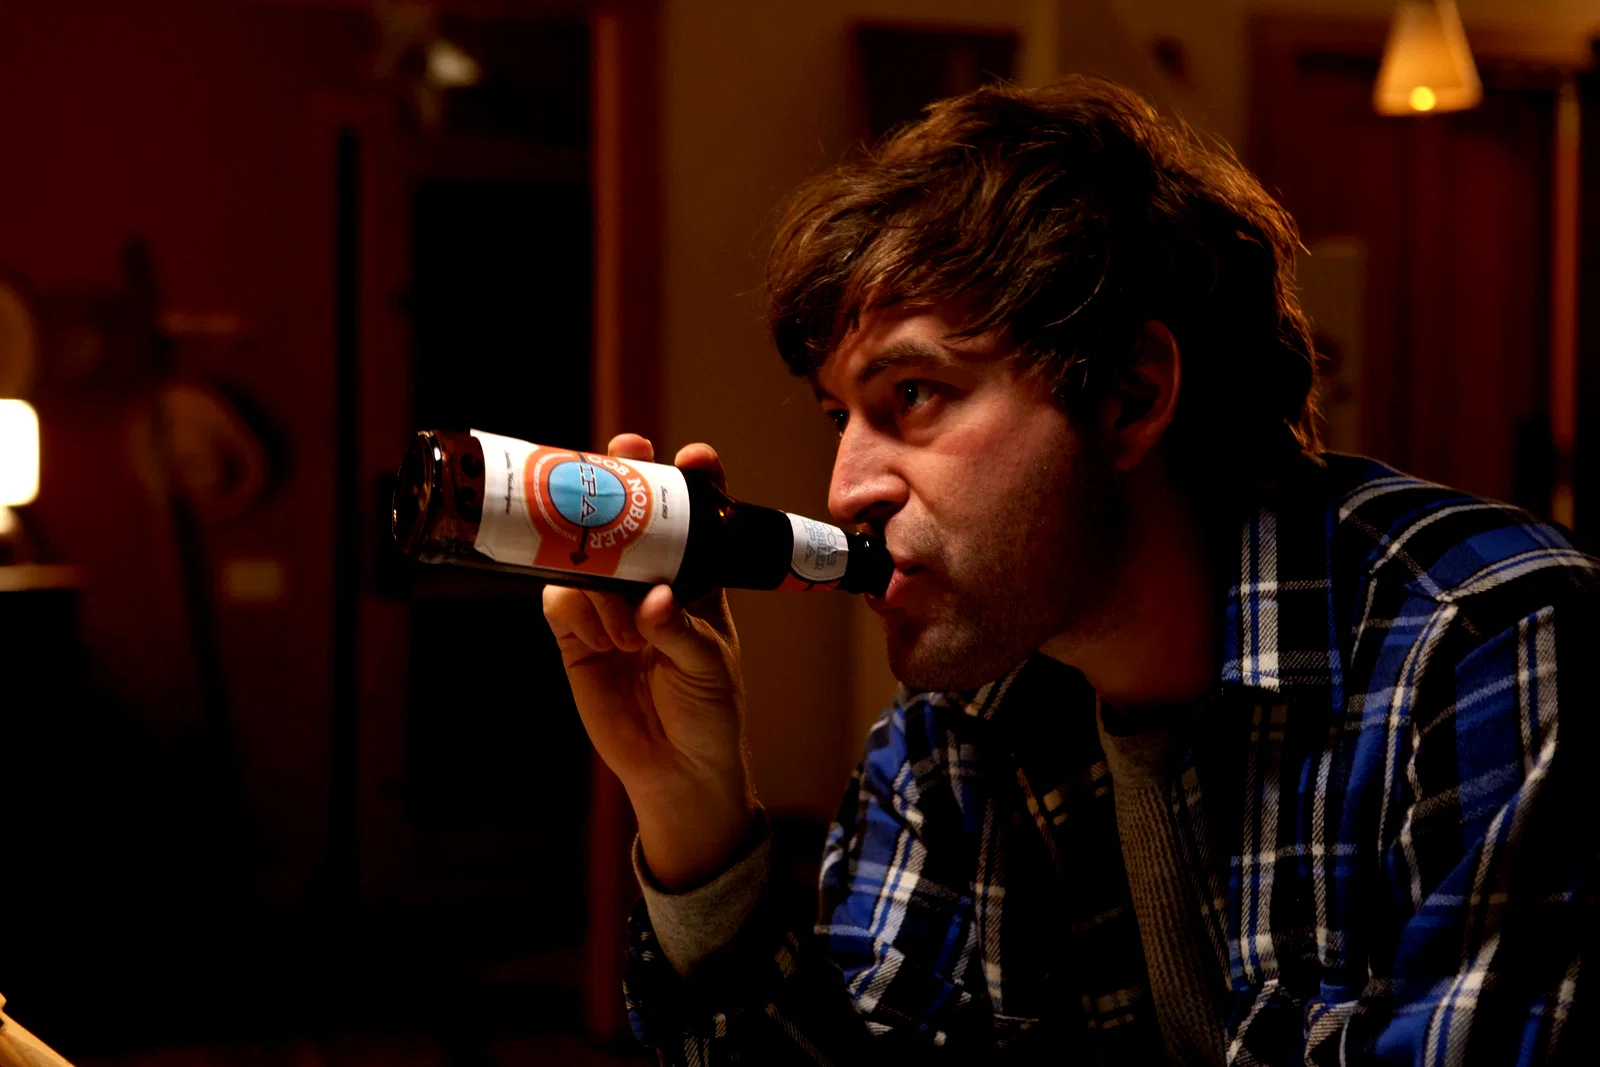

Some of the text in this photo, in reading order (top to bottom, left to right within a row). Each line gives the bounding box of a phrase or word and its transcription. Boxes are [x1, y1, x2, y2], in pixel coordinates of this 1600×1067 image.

[579, 464, 598, 524] IPA
[588, 455, 648, 549] COB NOBBLER
